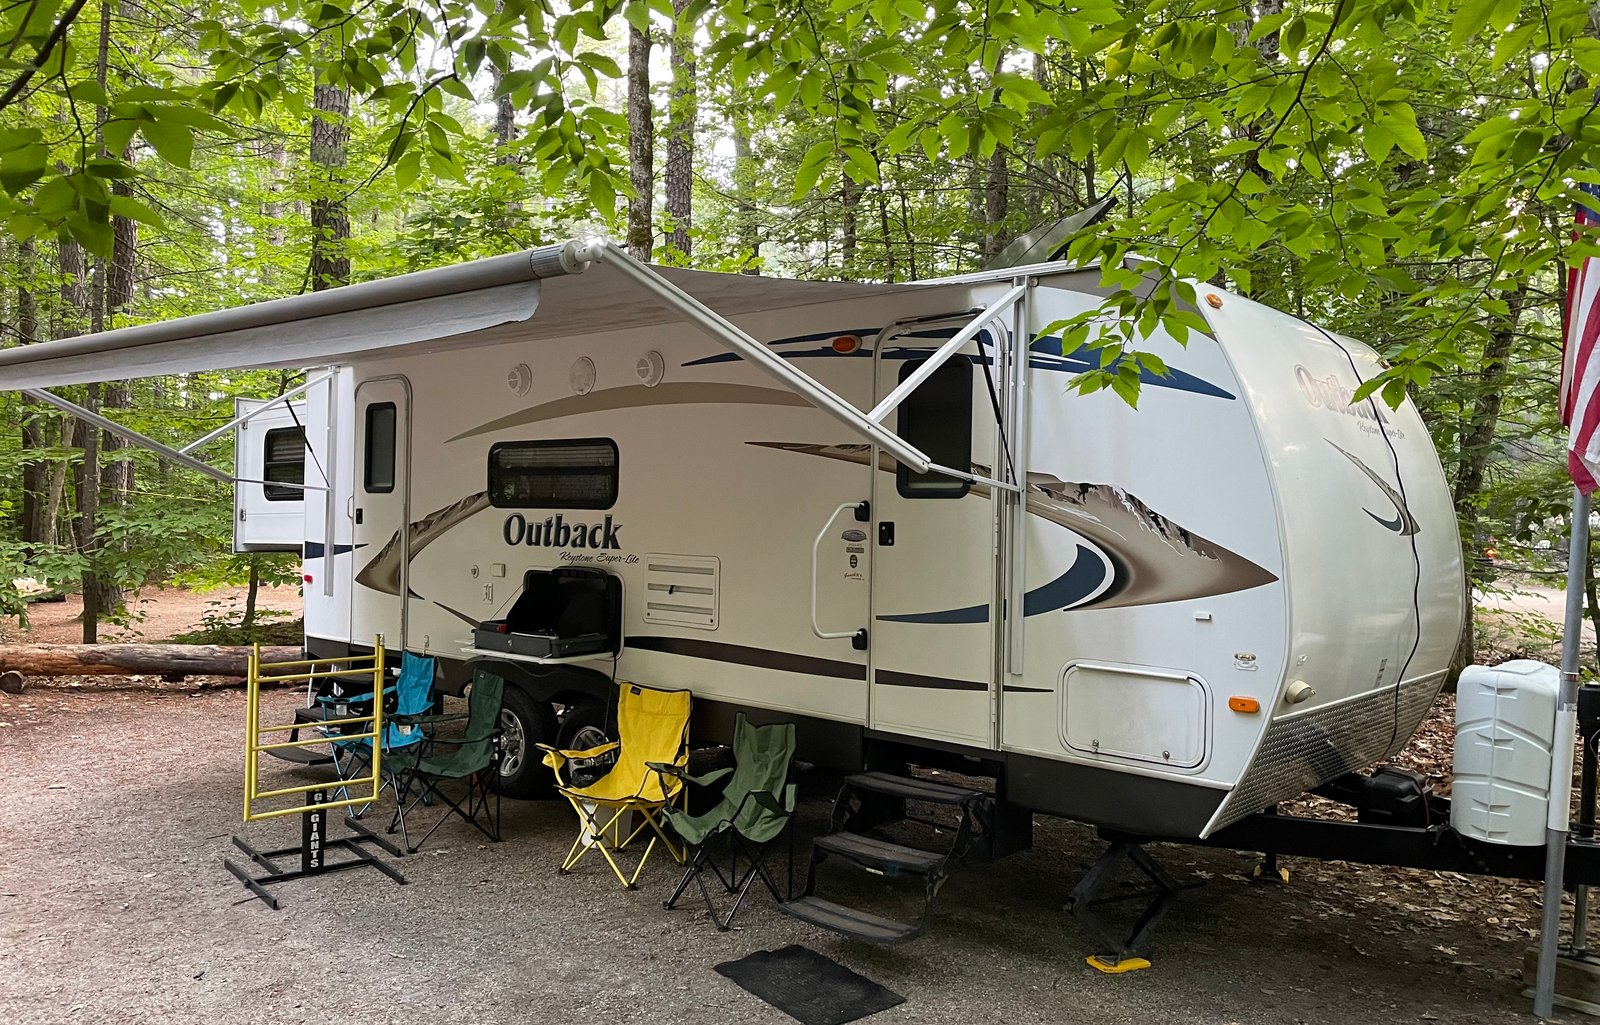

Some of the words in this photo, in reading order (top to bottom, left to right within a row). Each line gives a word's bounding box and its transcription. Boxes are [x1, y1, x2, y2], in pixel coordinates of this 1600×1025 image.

[503, 512, 622, 549] Outback
[559, 551, 594, 565] Keystone
[310, 814, 320, 868] GIANTS
